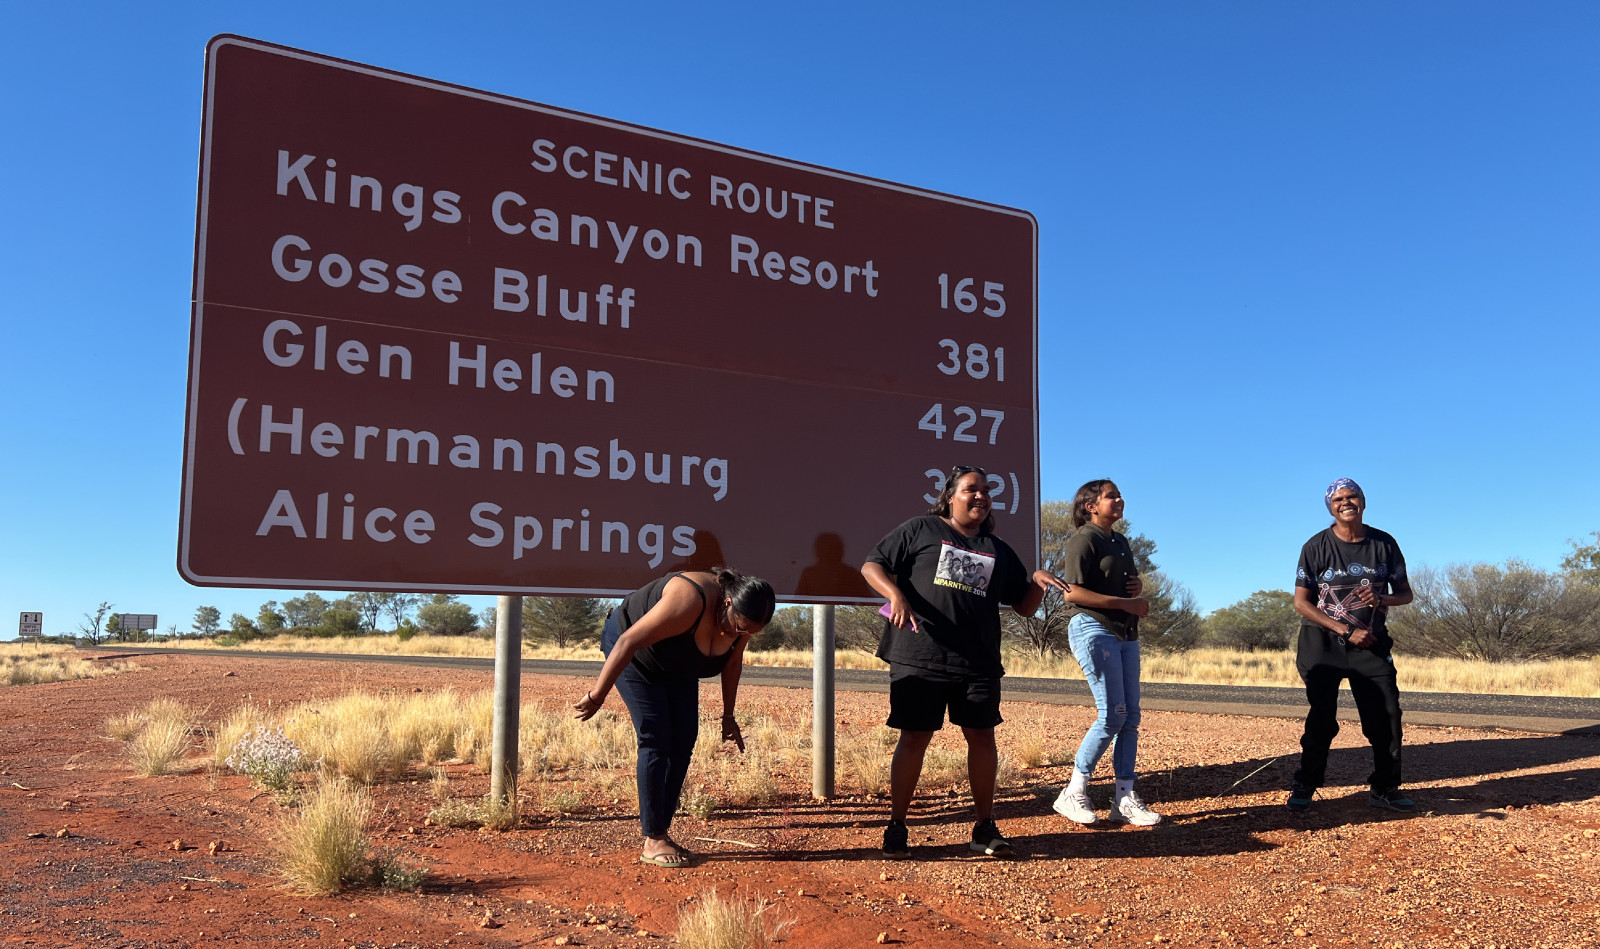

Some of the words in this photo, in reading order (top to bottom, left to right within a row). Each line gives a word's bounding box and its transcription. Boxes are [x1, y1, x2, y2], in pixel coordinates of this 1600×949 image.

[276, 149, 462, 232] Kings
[491, 190, 703, 267] Canyon
[730, 234, 880, 298] Resort
[938, 273, 1006, 318] 165
[531, 139, 692, 200] SCENIC
[710, 175, 835, 230] ROUTE
[271, 234, 463, 304] Gosse
[493, 267, 636, 329] Bluff
[936, 338, 1006, 382] 381
[262, 319, 413, 380] Glen
[448, 341, 616, 403] Helen
[918, 403, 1005, 445] 427
[227, 397, 729, 502] (Hermannsburg
[922, 468, 1020, 515] 32)
[255, 489, 436, 545] Alice
[468, 501, 697, 570] Springs
